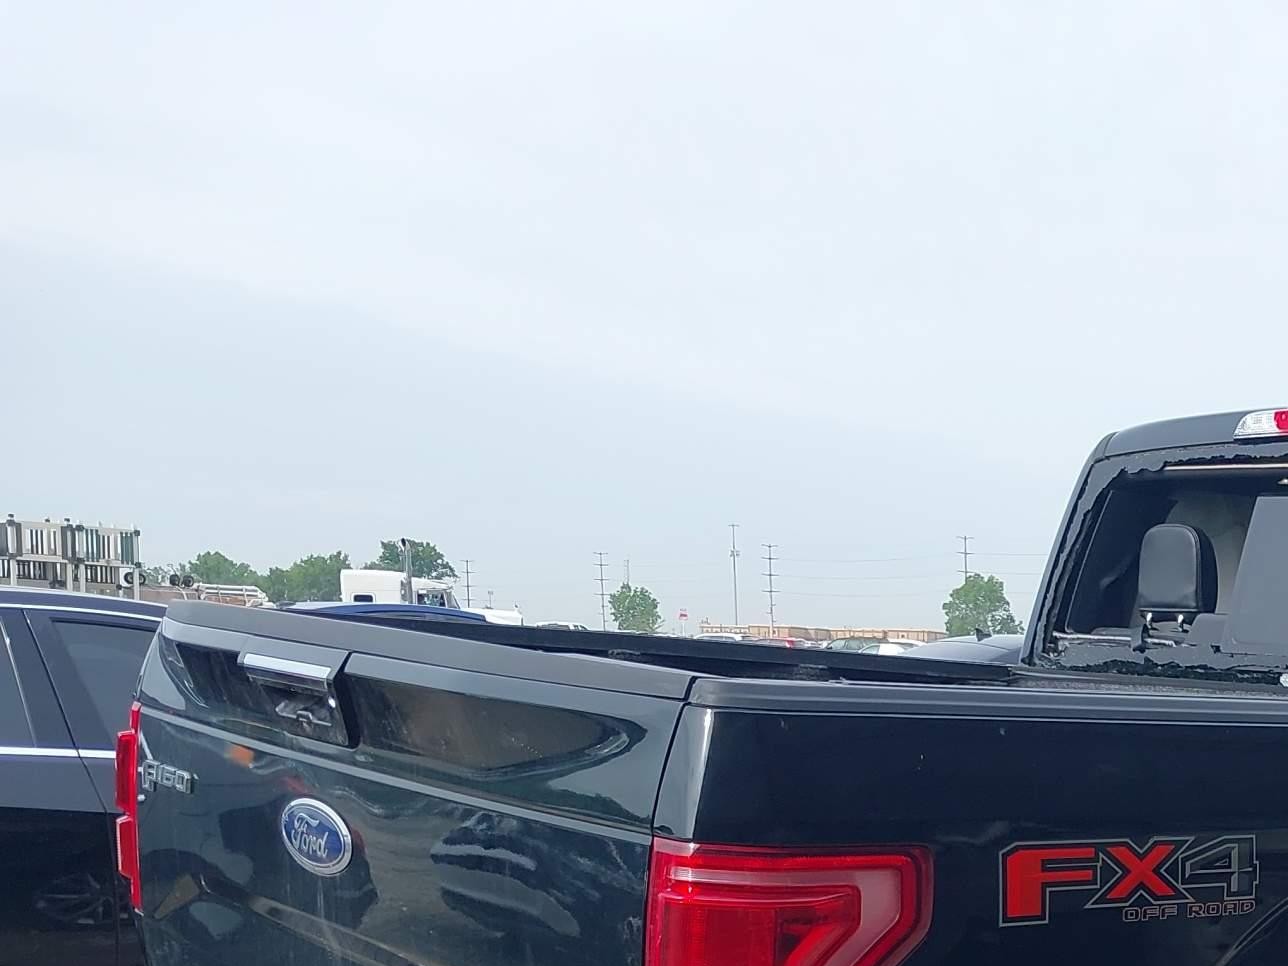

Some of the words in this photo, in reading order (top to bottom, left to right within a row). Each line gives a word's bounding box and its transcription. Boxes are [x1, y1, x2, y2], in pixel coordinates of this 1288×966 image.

[291, 812, 328, 858] Ford
[999, 835, 1259, 927] FX4
[1123, 904, 1178, 922] OFF
[1187, 899, 1256, 918] ROAD
